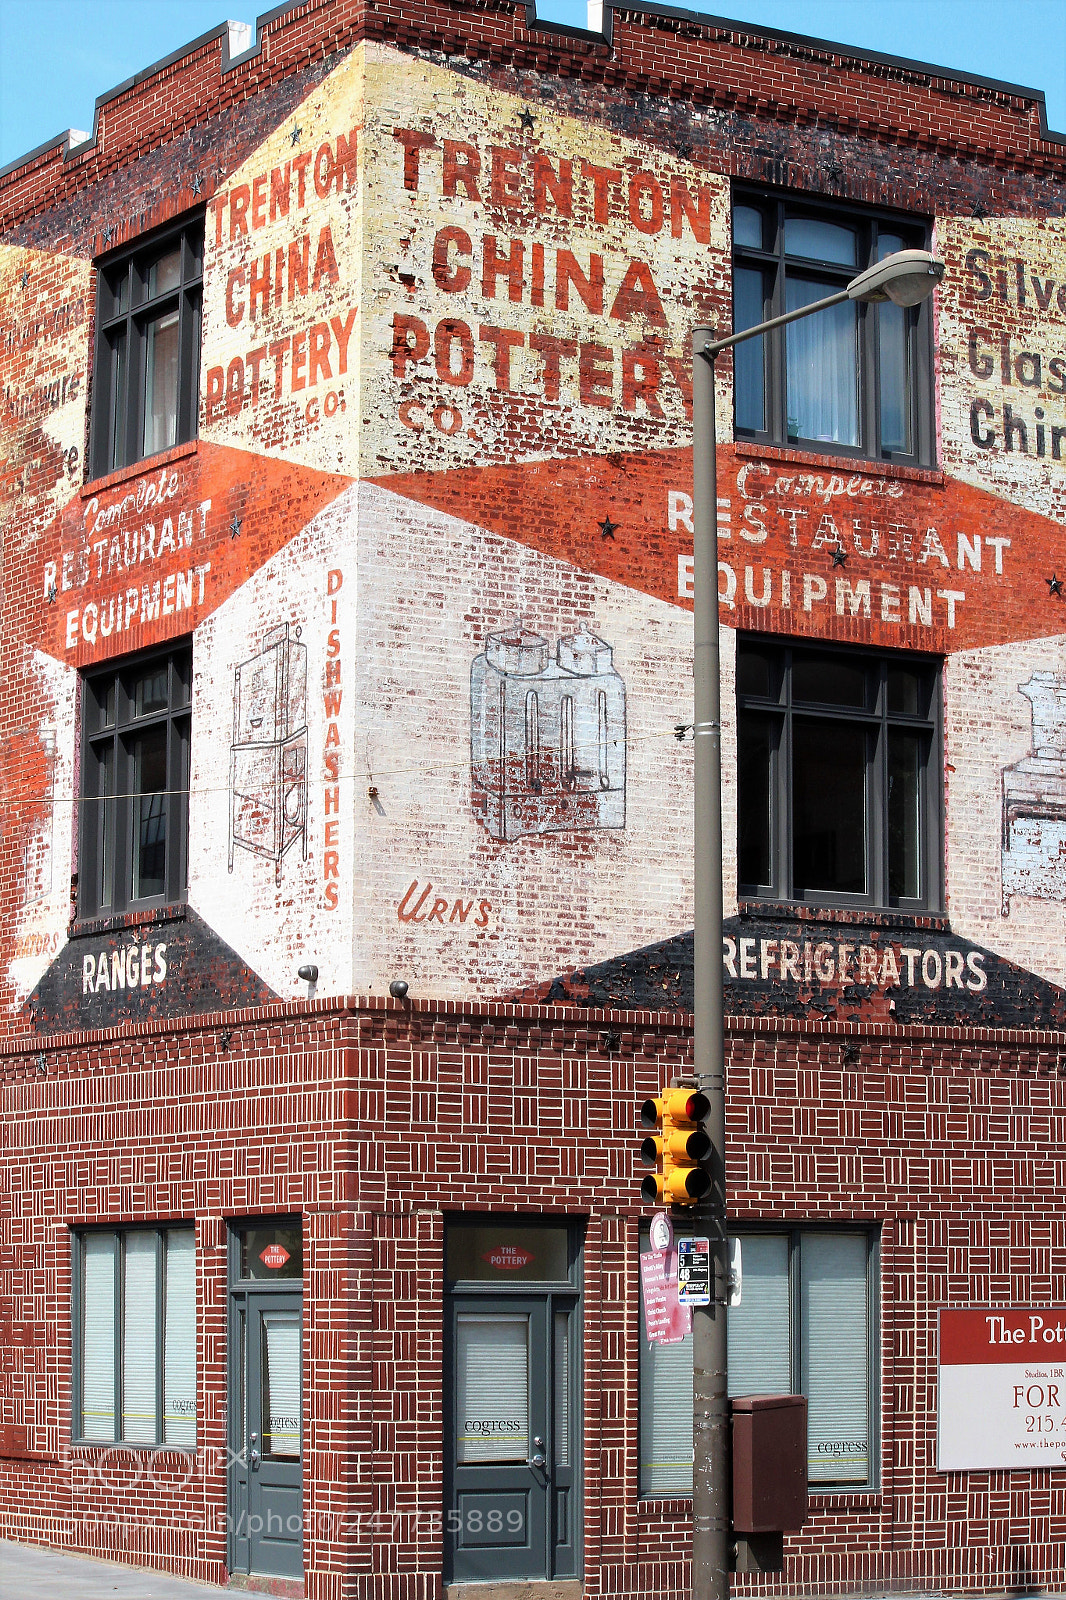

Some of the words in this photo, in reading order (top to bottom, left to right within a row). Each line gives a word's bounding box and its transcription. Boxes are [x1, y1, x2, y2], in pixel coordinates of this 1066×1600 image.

[209, 125, 363, 249] TRENTON
[394, 127, 712, 245] TRENTON
[225, 225, 340, 328] CHINA
[431, 225, 670, 329] CHINA
[205, 306, 359, 425] POTTERY
[736, 461, 904, 505] Complete
[43, 499, 212, 599] RESTAURANT
[65, 562, 212, 649] EQUIPMENT
[677, 554, 967, 629] EQUIPMENT
[323, 568, 344, 912] DISHWASHERS
[82, 942, 168, 995] RANGES
[722, 936, 989, 992] REFRIGERATORS
[264, 1255, 286, 1264] POTTERY
[270, 1246, 280, 1254] THE
[490, 1255, 528, 1265] POTTERY
[500, 1246, 517, 1255] THE
[680, 1255, 685, 1267] 5
[679, 1269, 690, 1280] 48
[985, 1315, 1026, 1344] The
[1013, 1384, 1061, 1408] FOR
[464, 1419, 521, 1437] cogress
[817, 1441, 868, 1457] cogress
